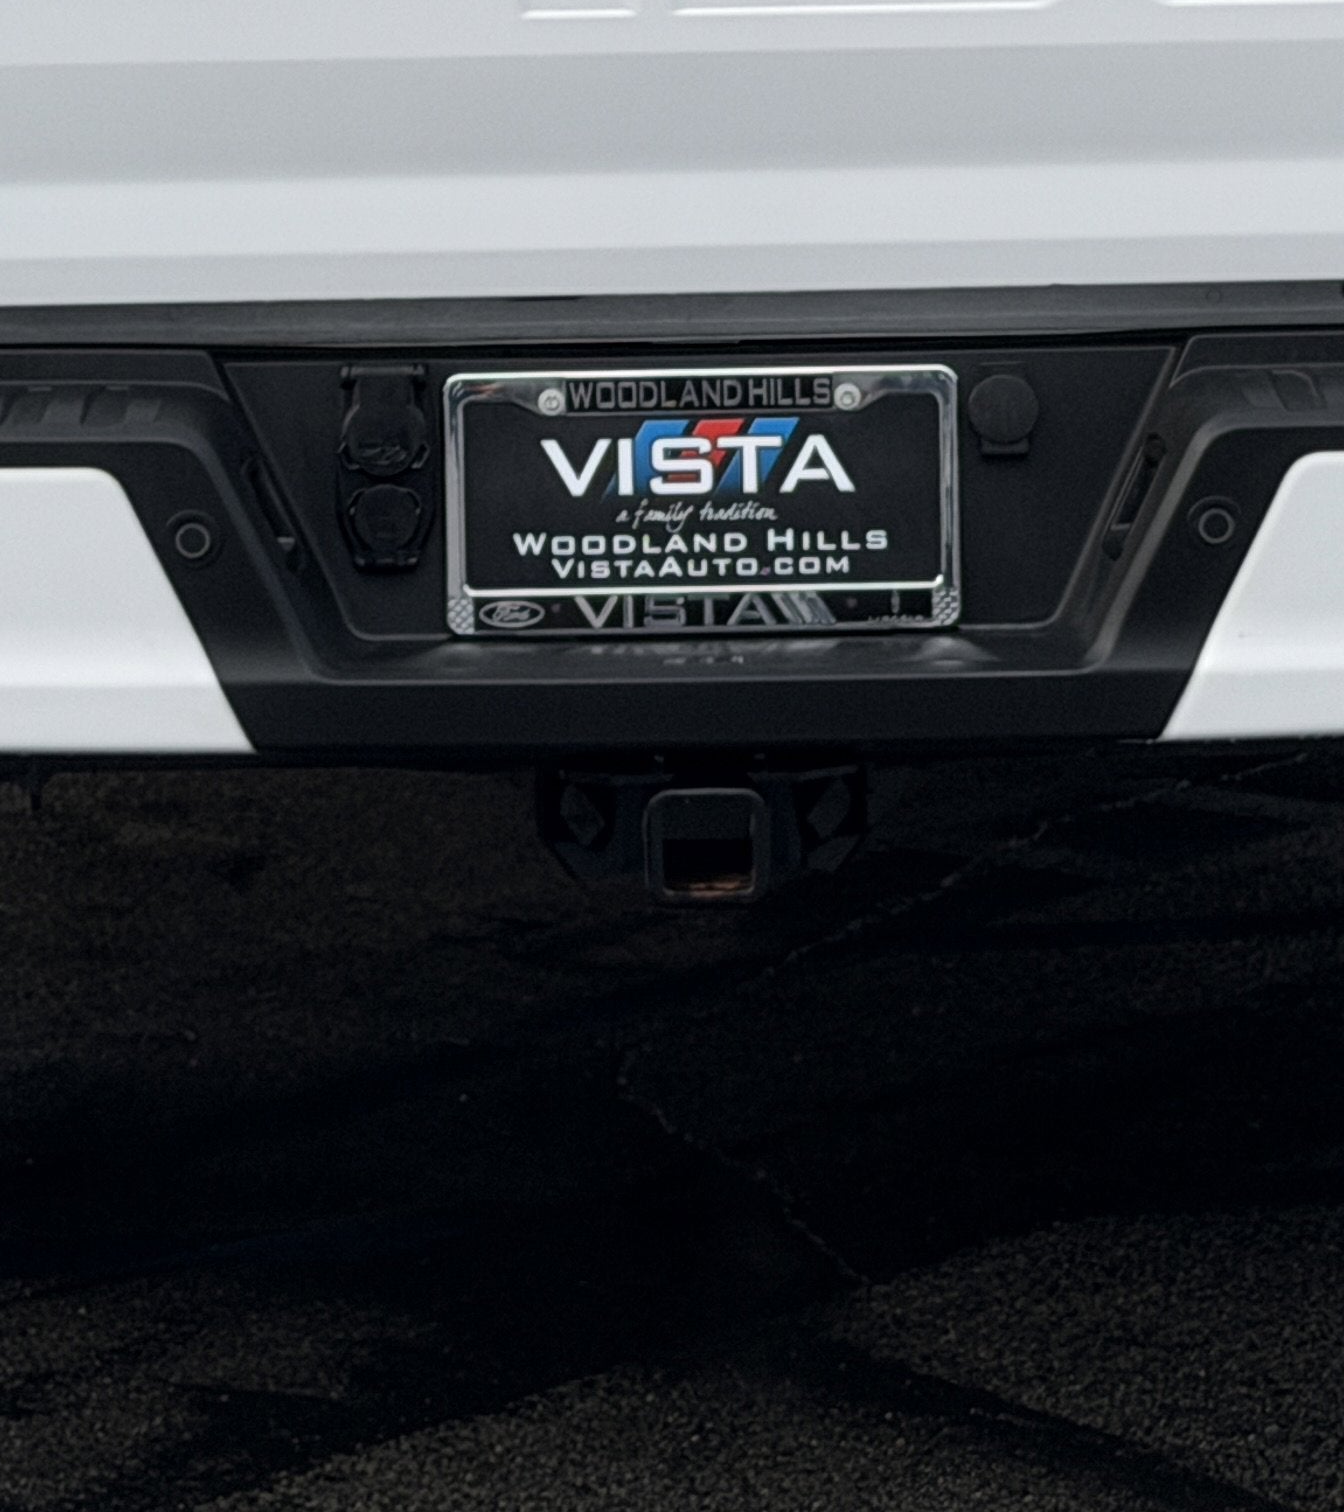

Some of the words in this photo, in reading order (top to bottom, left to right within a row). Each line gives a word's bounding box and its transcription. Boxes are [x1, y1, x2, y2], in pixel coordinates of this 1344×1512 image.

[568, 379, 743, 409] WOODLAND
[747, 377, 832, 407] HILLS
[539, 433, 856, 498] VISTA
[615, 509, 631, 523] a
[632, 498, 695, 533] family
[699, 499, 779, 522] tradition
[512, 531, 748, 557] WOODLAND
[766, 527, 888, 552] HILLS
[574, 591, 778, 629] VISTA
